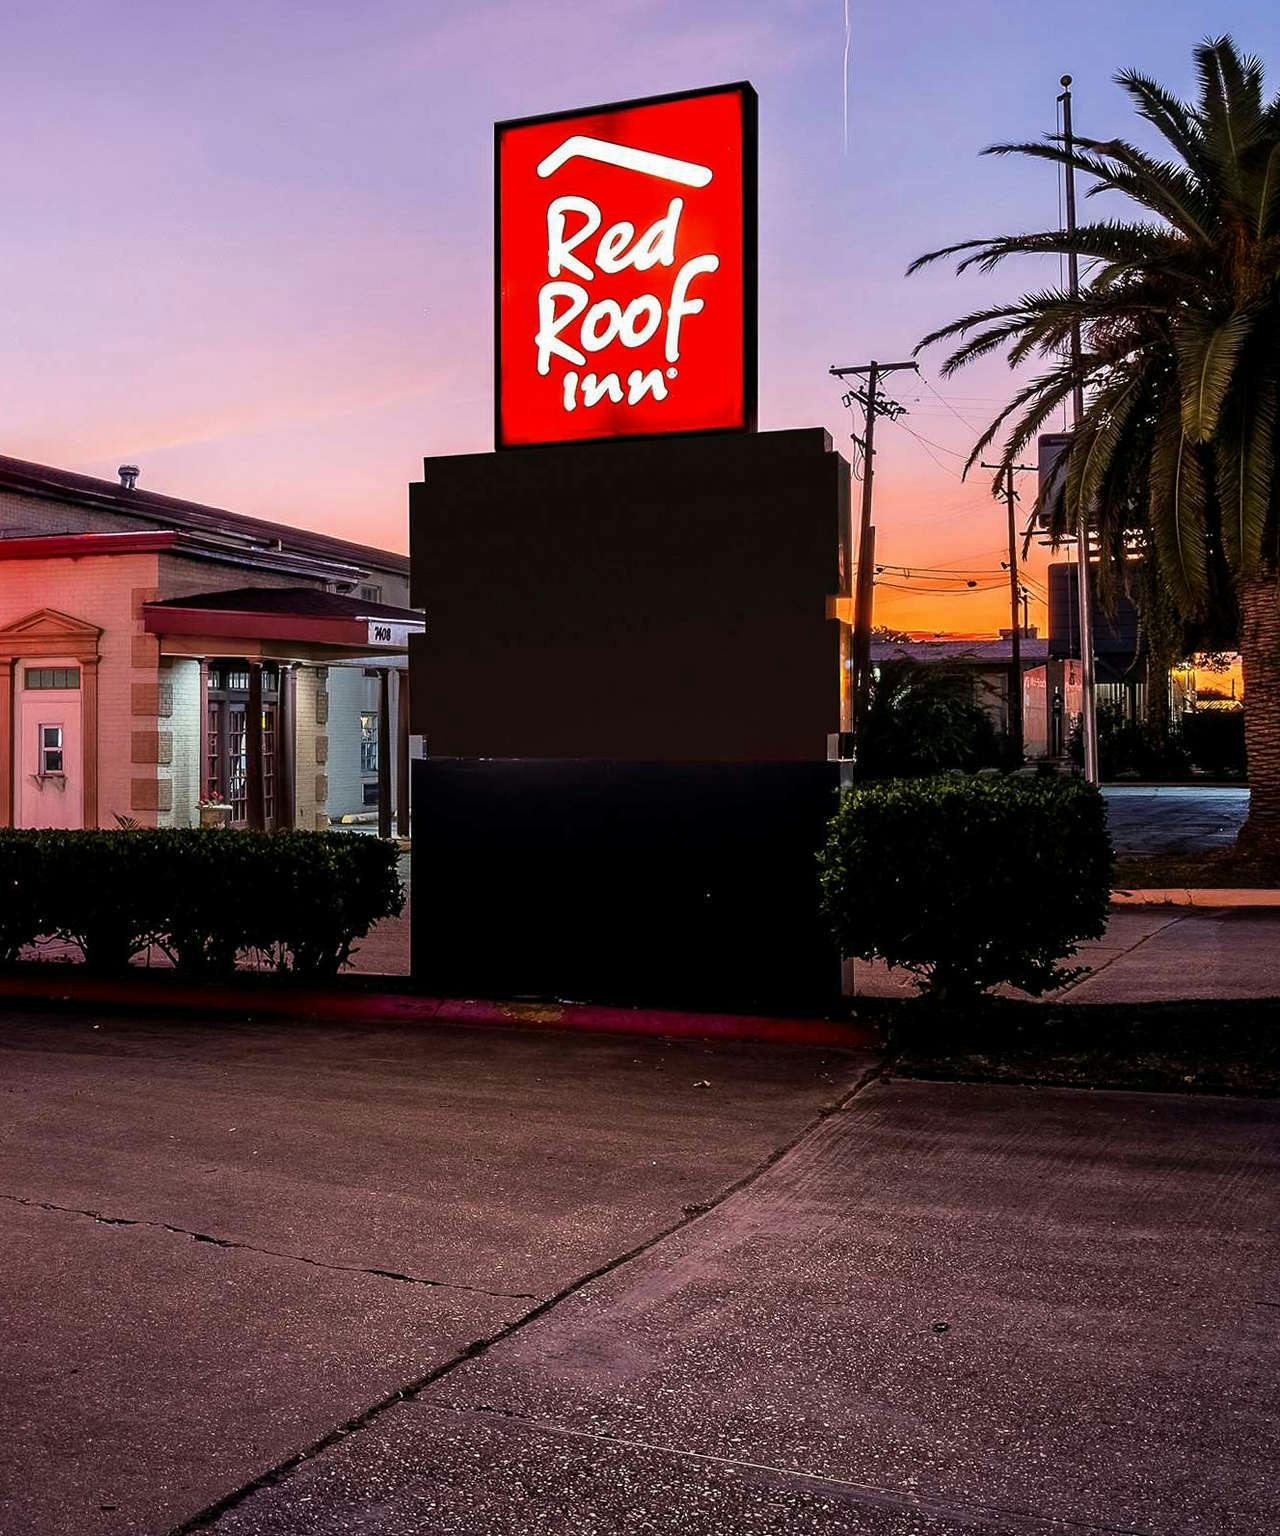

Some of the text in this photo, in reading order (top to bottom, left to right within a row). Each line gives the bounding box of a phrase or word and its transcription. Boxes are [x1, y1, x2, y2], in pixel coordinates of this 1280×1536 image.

[547, 195, 684, 281] Red
[534, 254, 720, 376] Roof
[374, 626, 392, 641] 7408
